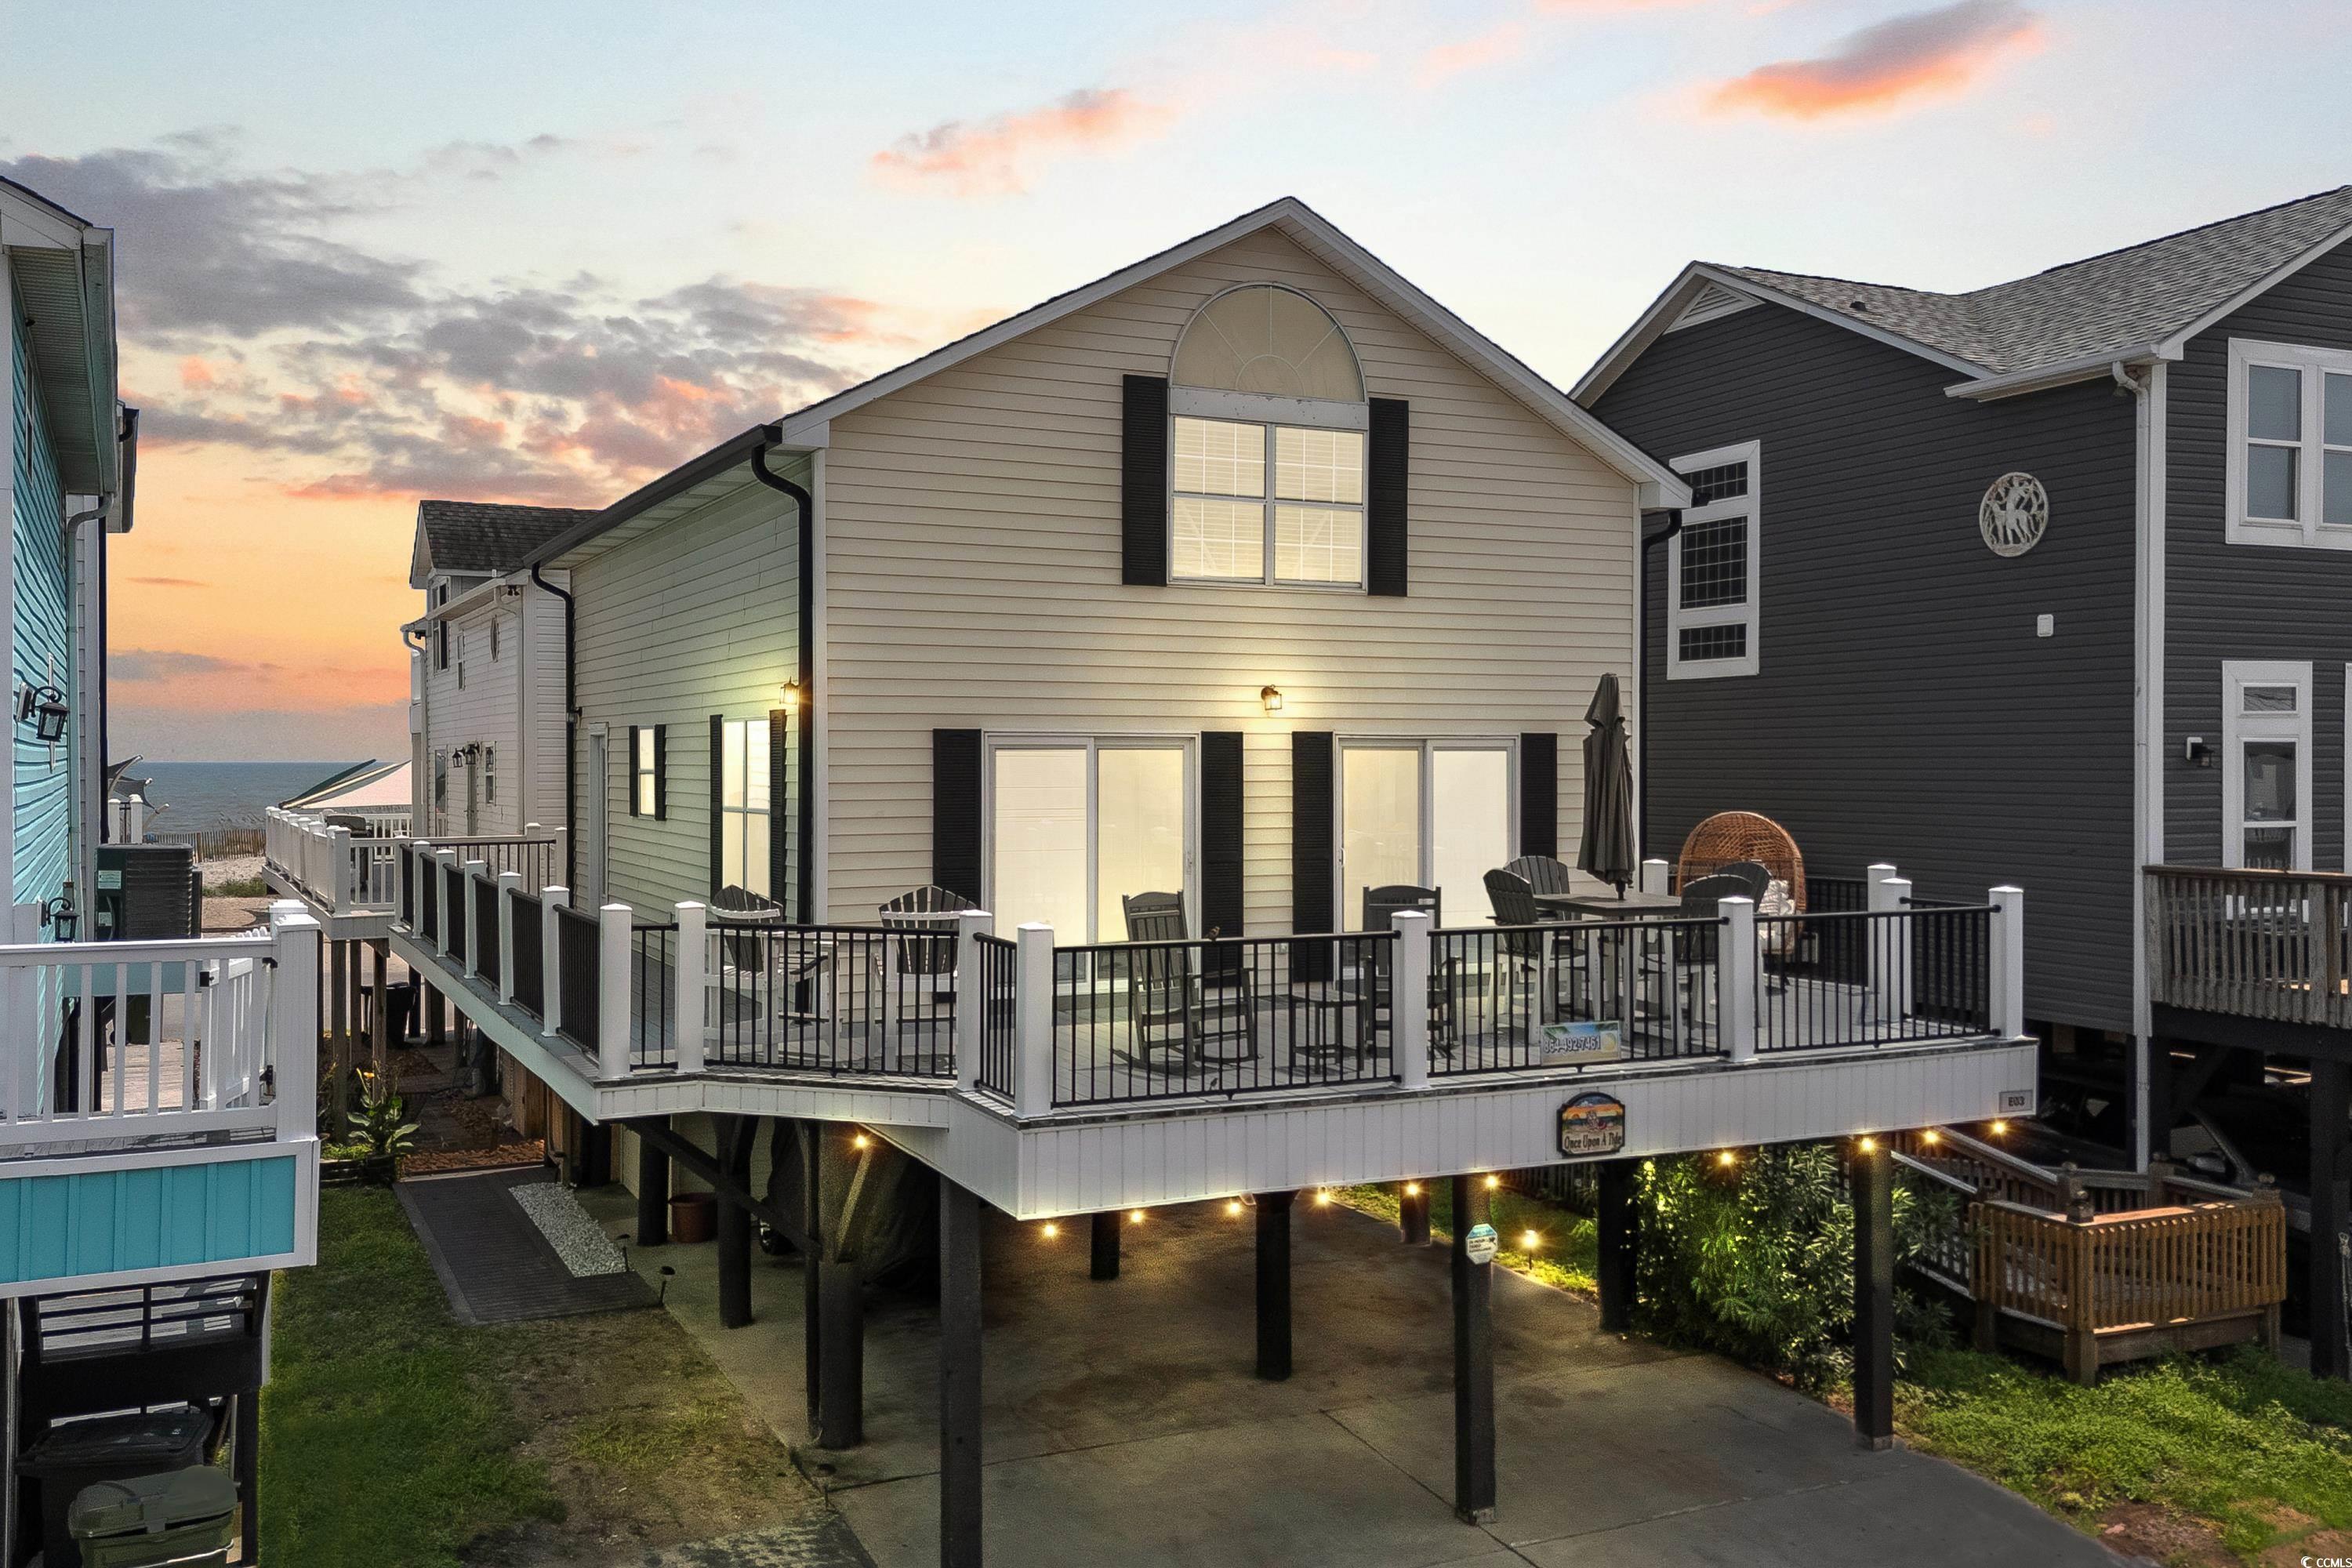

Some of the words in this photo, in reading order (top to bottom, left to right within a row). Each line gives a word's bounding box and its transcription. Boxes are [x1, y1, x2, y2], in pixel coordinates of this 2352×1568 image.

[1564, 1135, 1581, 1149] Once
[1583, 1134, 1600, 1151] Upon
[1602, 1131, 1607, 1145] A
[1608, 1131, 1623, 1145] Tide
